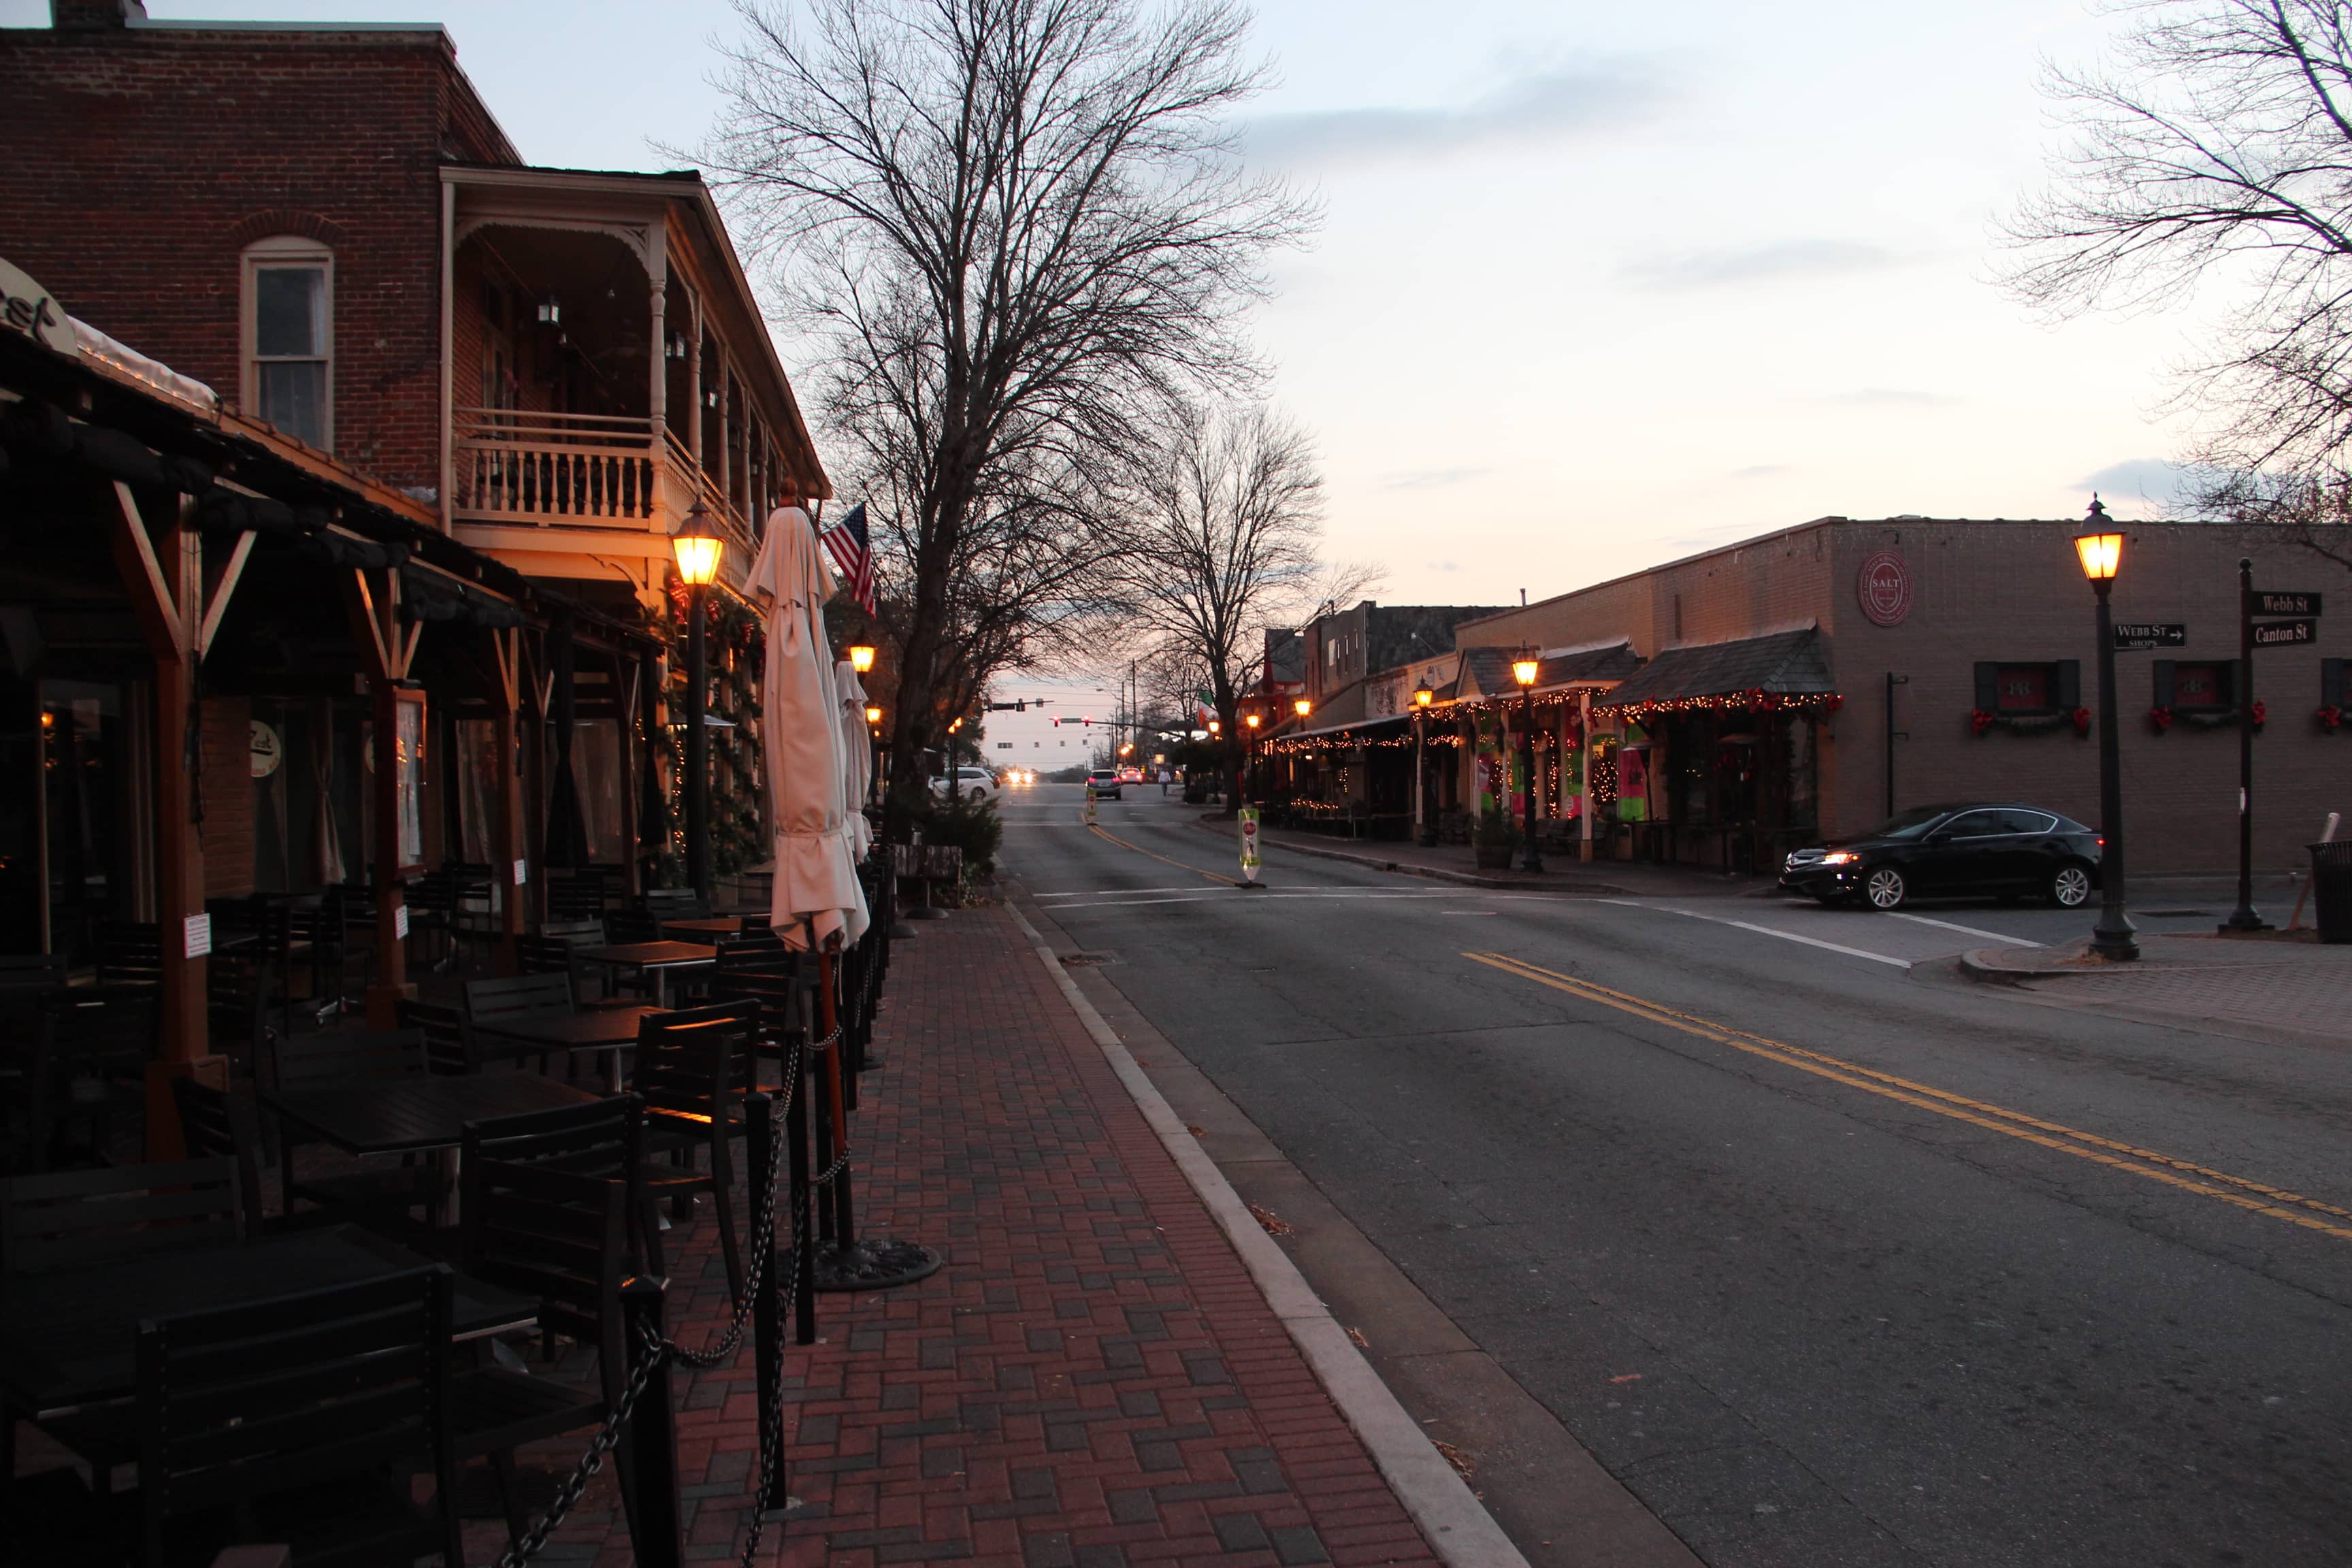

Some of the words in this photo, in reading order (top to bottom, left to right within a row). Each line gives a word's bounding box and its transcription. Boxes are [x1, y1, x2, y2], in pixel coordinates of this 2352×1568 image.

[1872, 578, 1899, 587] SALT
[2263, 595, 2294, 611] Webb
[2296, 597, 2308, 612] St
[2255, 627, 2293, 643] Canton
[2296, 624, 2308, 640] St
